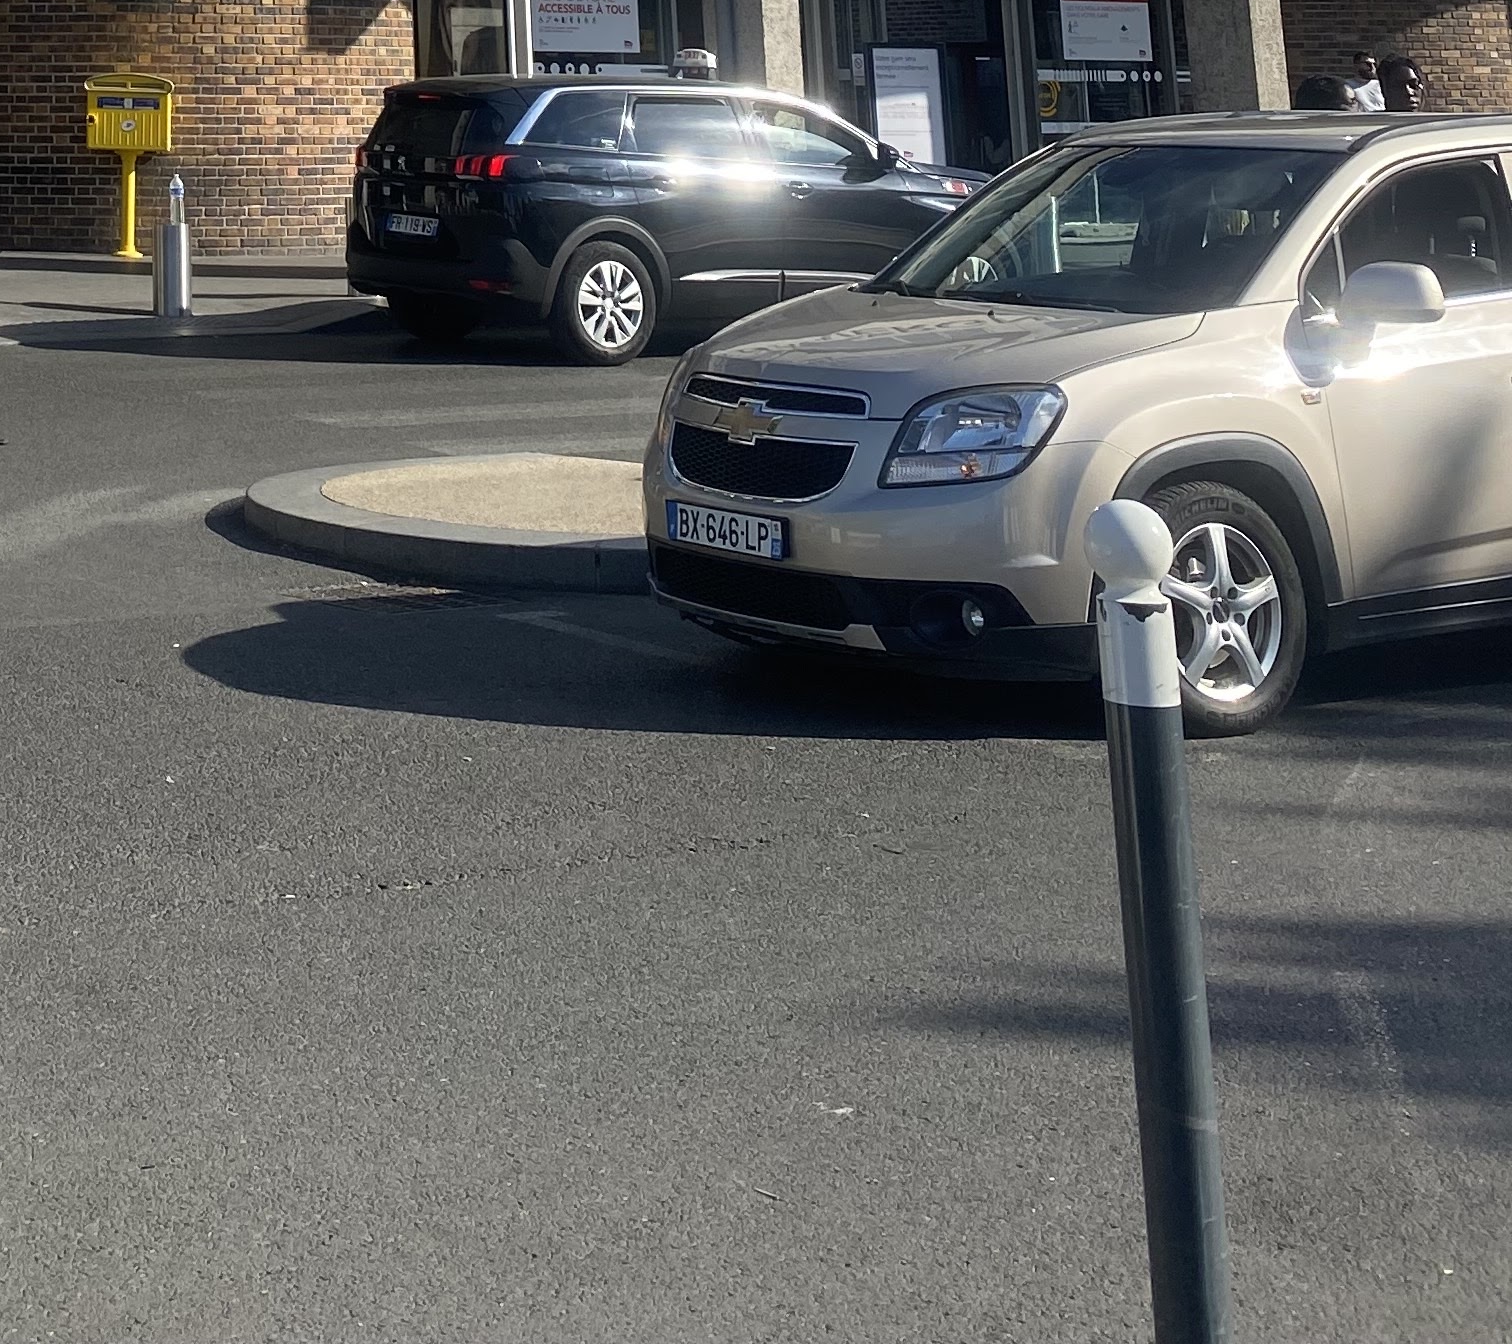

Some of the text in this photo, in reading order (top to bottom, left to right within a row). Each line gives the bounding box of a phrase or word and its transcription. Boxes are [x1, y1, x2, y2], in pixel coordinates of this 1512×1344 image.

[538, 3, 594, 14] ACCESSIBLE
[605, 4, 631, 15] TOUS
[679, 508, 769, 553] BX-646-LP
